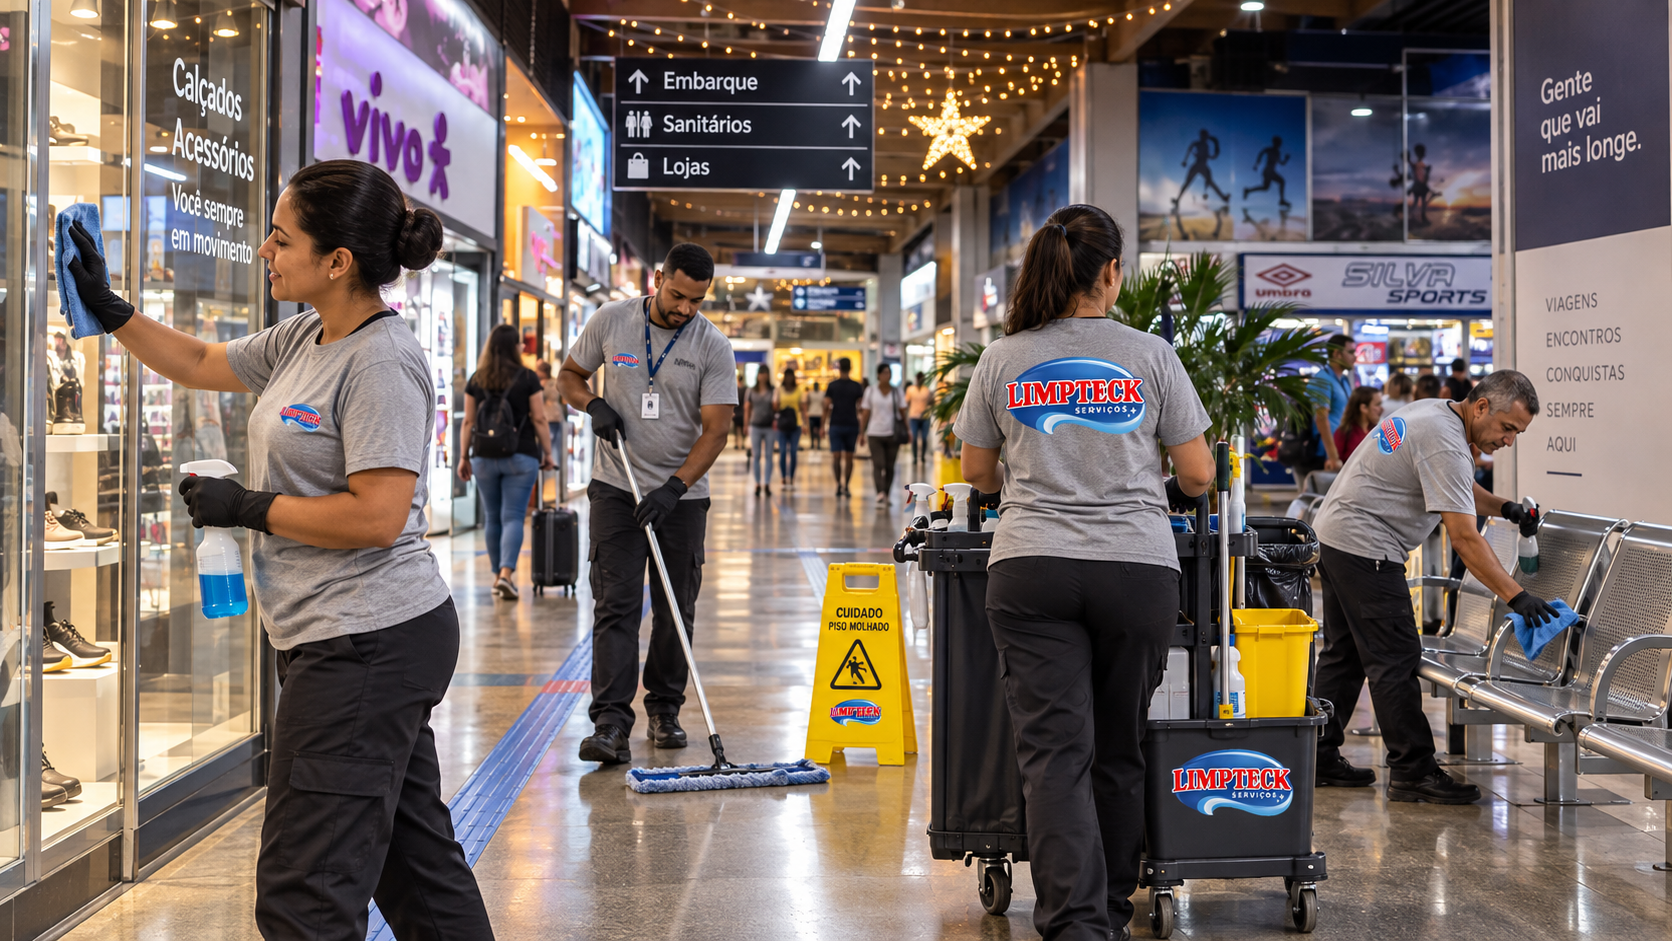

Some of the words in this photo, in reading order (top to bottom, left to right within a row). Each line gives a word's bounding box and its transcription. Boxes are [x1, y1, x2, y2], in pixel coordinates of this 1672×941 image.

[173, 57, 242, 122] Calçados
[663, 71, 758, 95] Embarque
[1541, 70, 1593, 104] Gente
[341, 71, 423, 183] vivo
[663, 114, 752, 134] Sanitários
[1541, 113, 1572, 144] que
[1576, 97, 1601, 129] vai
[172, 117, 254, 182] Acessórios
[1542, 140, 1581, 174] mais
[1586, 130, 1642, 162] longe.
[663, 157, 710, 179] Lojas
[172, 182, 202, 217] Você
[204, 198, 244, 230] sempre
[171, 228, 191, 251] em
[193, 231, 253, 265] movimento
[1342, 262, 1456, 288] SILVA
[1386, 289, 1488, 305] SPORTS
[1546, 292, 1598, 313] VIAGENS
[1546, 327, 1622, 348] ENCONTROS
[1546, 364, 1625, 383] CONQUISTAS
[1005, 378, 1145, 410] LIMPTECK
[1074, 405, 1128, 415] SERVIÇOS
[1546, 402, 1595, 418] SEMPRE
[1546, 436, 1577, 453] AQUI
[836, 607, 883, 619] CUIDADO
[828, 621, 847, 631] PISO
[849, 621, 890, 632] MOLHADO
[1172, 767, 1292, 793] LIMPTECK
[1231, 791, 1277, 799] SERVIÇOS
